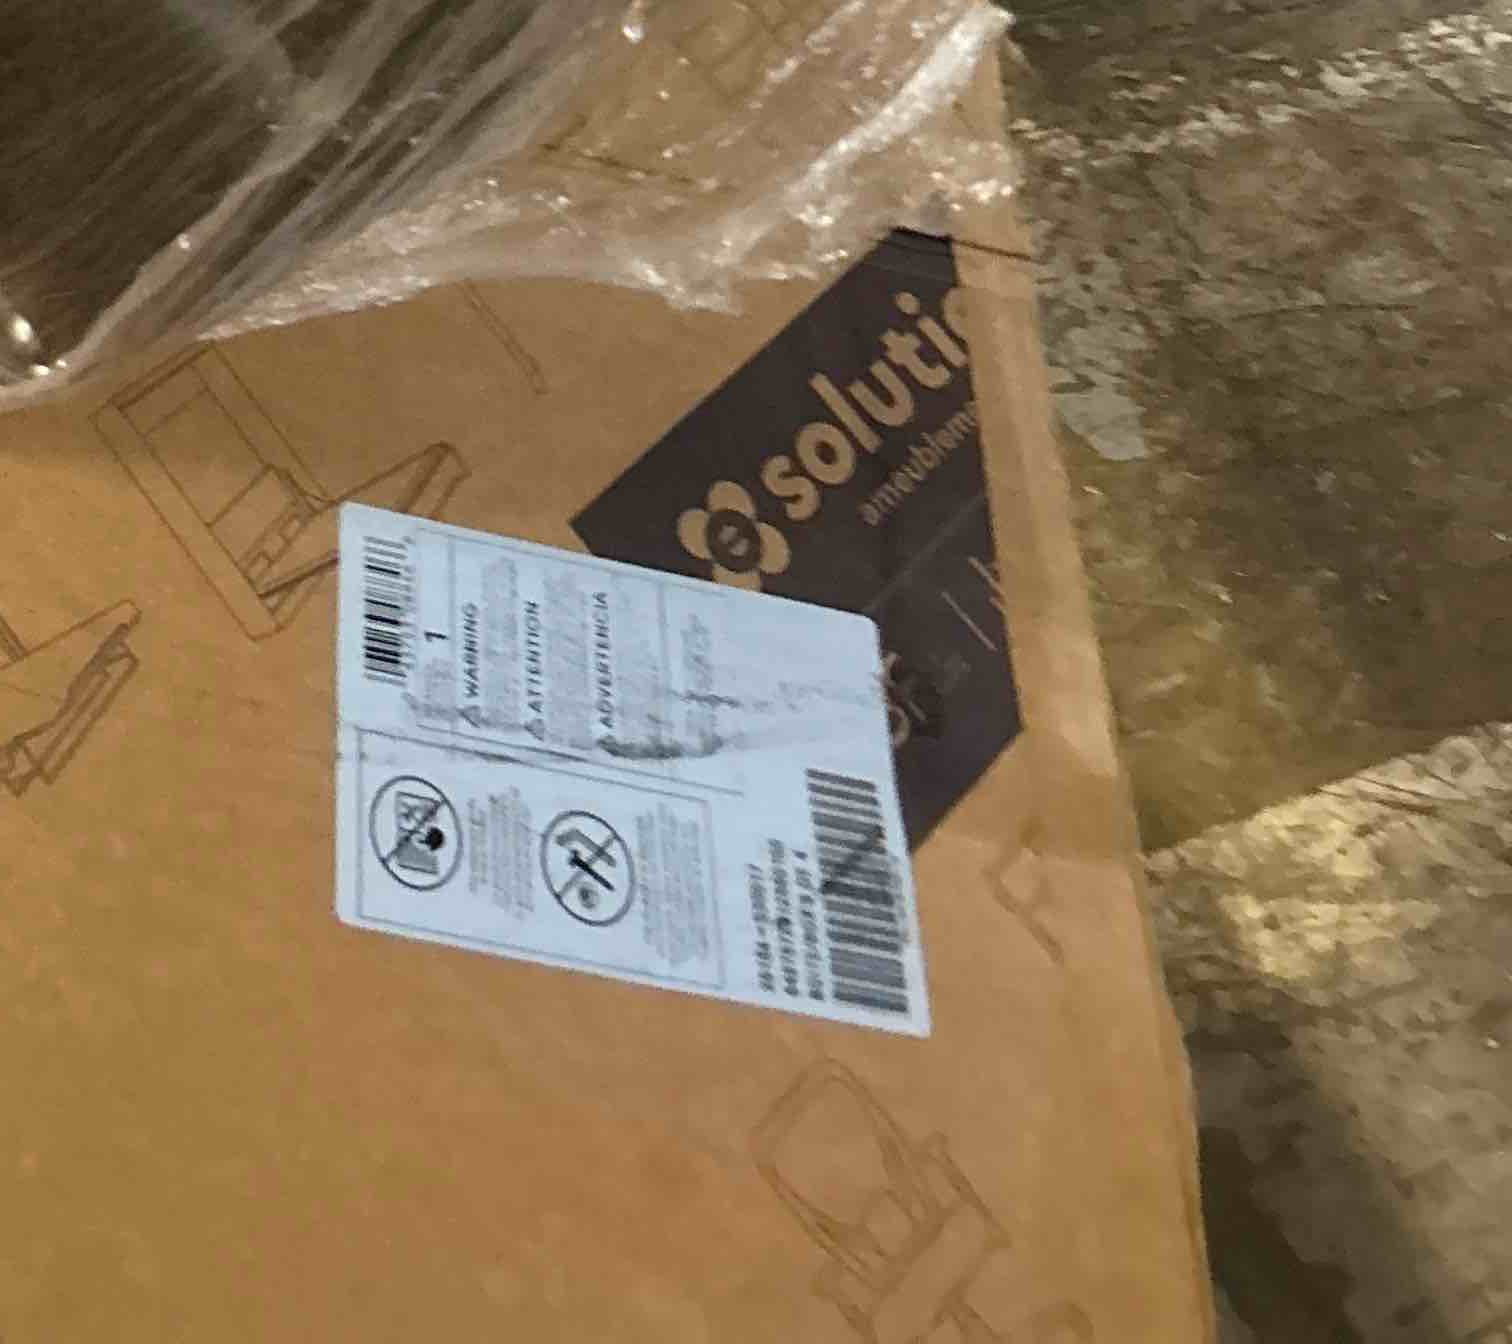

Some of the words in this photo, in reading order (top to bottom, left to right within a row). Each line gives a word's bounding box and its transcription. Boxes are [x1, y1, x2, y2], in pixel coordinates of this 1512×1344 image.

[461, 601, 480, 700] WARNING
[524, 599, 544, 713] ATTENTION
[592, 590, 616, 729] ADVERTENCIA
